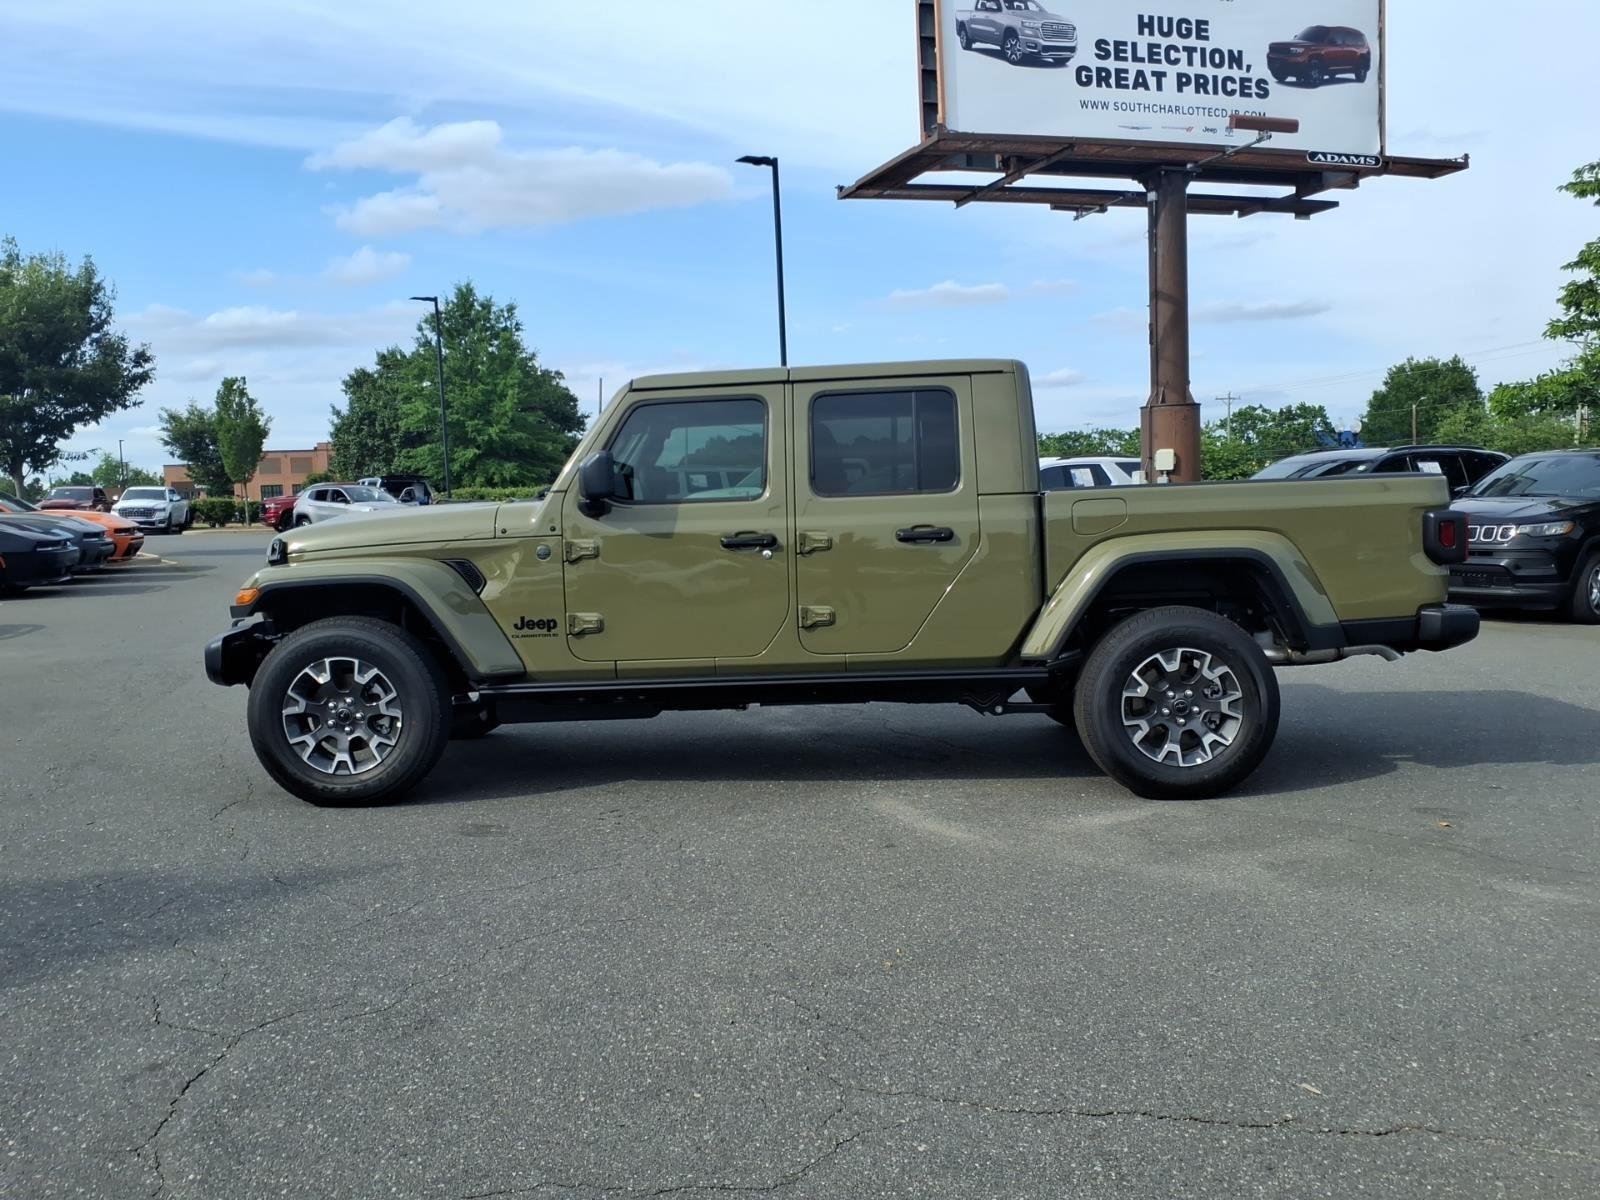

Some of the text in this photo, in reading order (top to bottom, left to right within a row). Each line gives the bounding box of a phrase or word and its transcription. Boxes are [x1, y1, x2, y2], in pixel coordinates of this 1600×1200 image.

[1137, 14, 1210, 41] HUGE
[1094, 38, 1253, 73] SELECTION,
[1075, 65, 1270, 100] GREAT PRICES
[1314, 153, 1376, 165] ADAMS
[513, 615, 558, 632] Jeep
